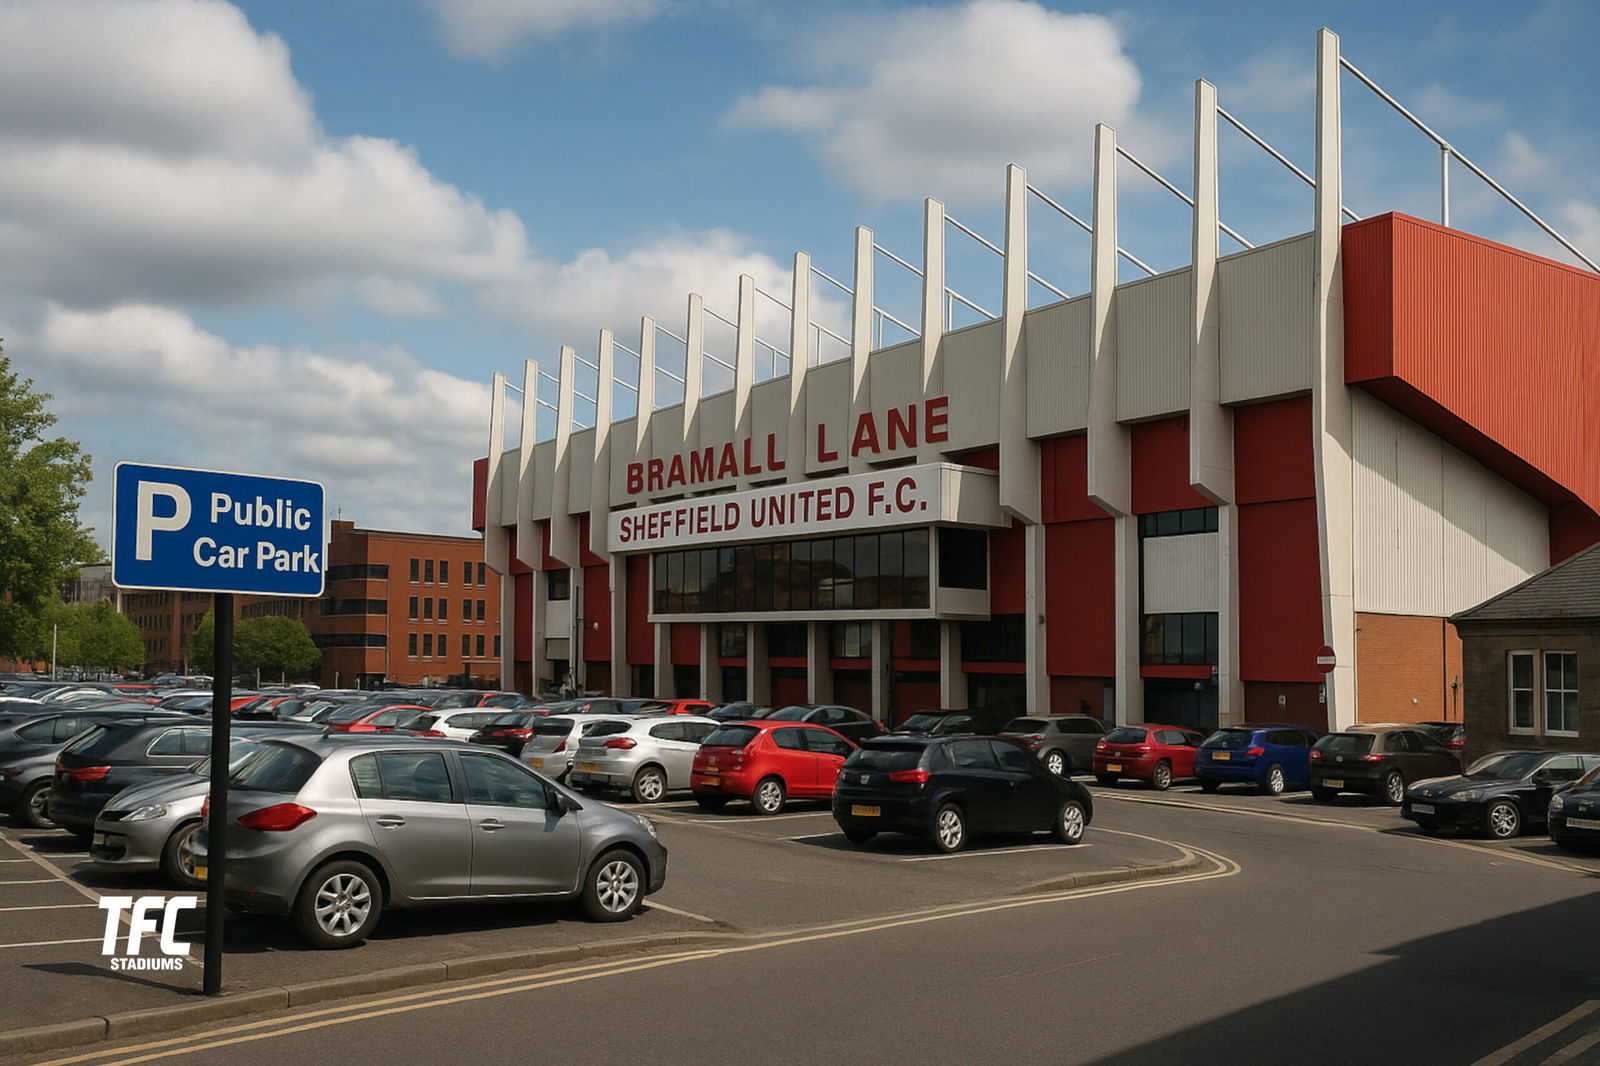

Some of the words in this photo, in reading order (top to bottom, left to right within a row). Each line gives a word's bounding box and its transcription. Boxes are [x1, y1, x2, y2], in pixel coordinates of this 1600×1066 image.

[627, 433, 786, 494] BRAMALL
[817, 396, 949, 463] LANE
[136, 480, 192, 561] P
[211, 492, 311, 531] Public
[619, 502, 740, 543] SHEFFIELD
[751, 486, 854, 528] UNITED
[868, 477, 928, 516] F.C.
[193, 537, 249, 568] Car
[257, 541, 320, 573] Park
